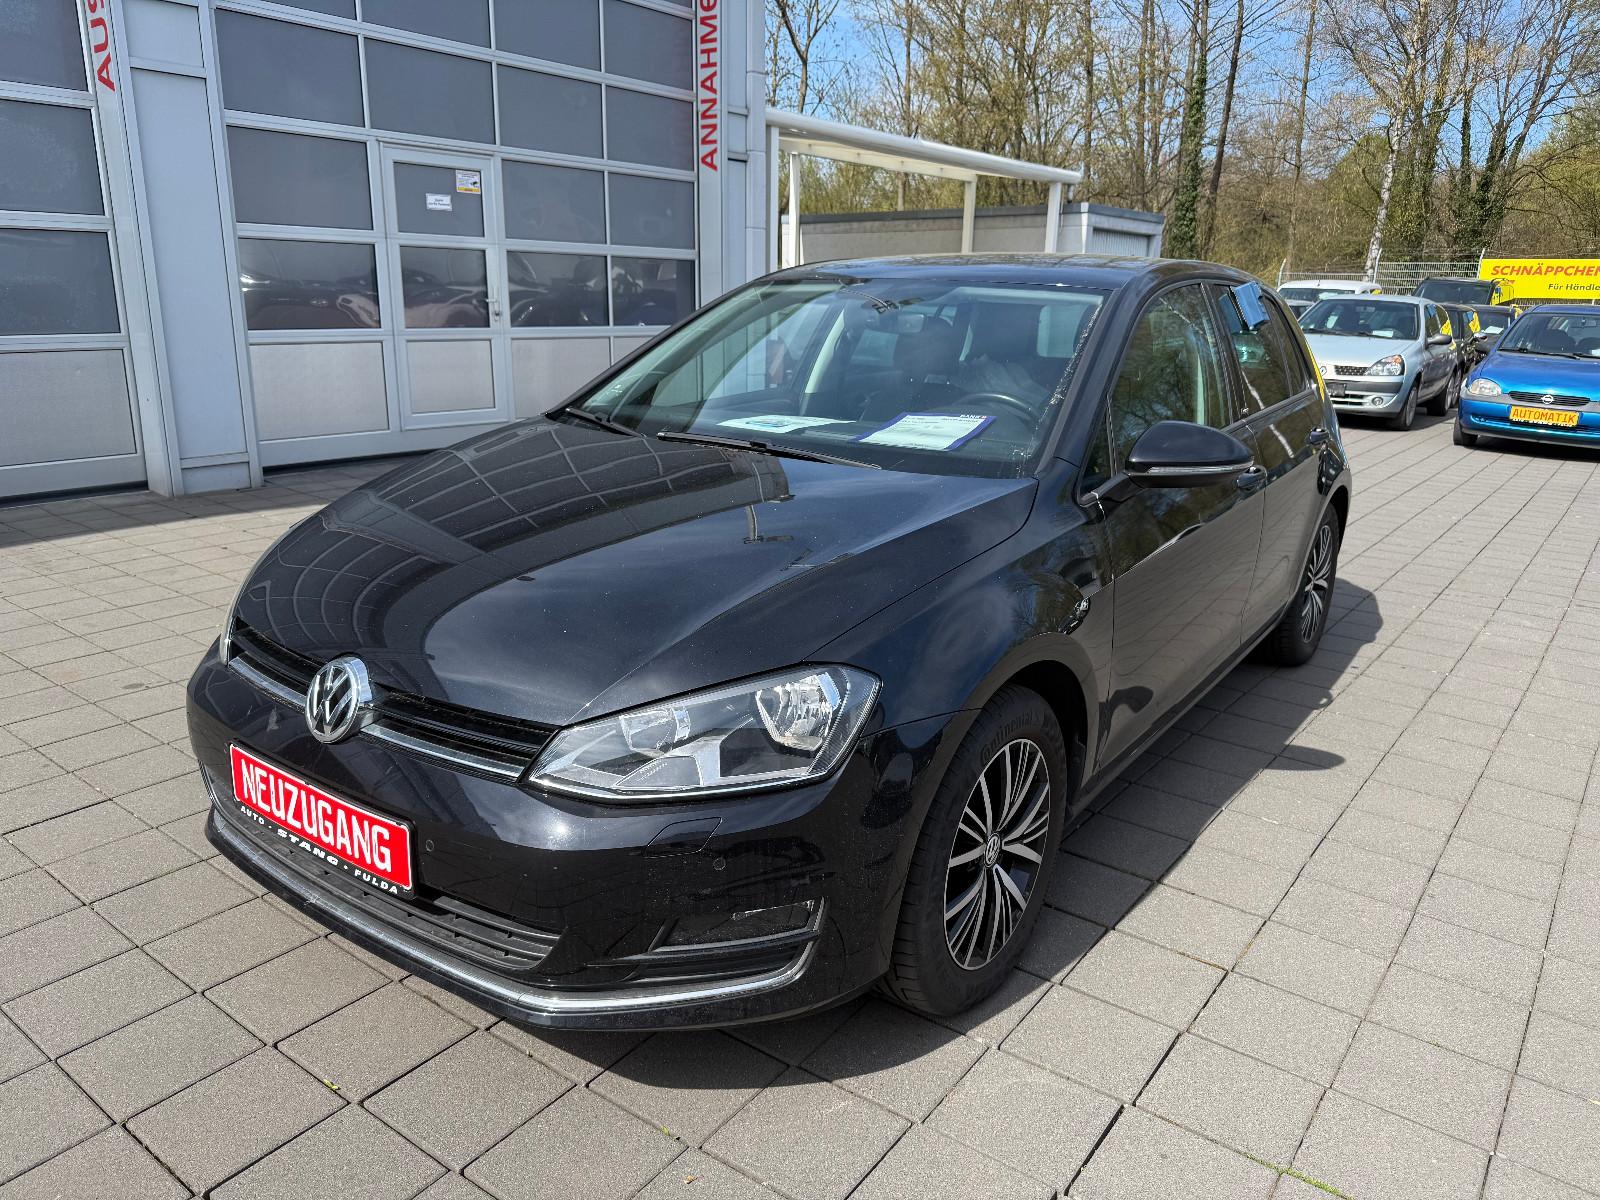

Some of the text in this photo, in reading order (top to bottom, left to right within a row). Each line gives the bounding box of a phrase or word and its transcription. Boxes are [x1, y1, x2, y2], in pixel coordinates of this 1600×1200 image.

[700, 0, 718, 172] ANNAHME
[1512, 408, 1578, 424] AUTOMATIK
[240, 805, 398, 895] AUTO STANG FULDA
[241, 758, 392, 873] NEUZUGANG
